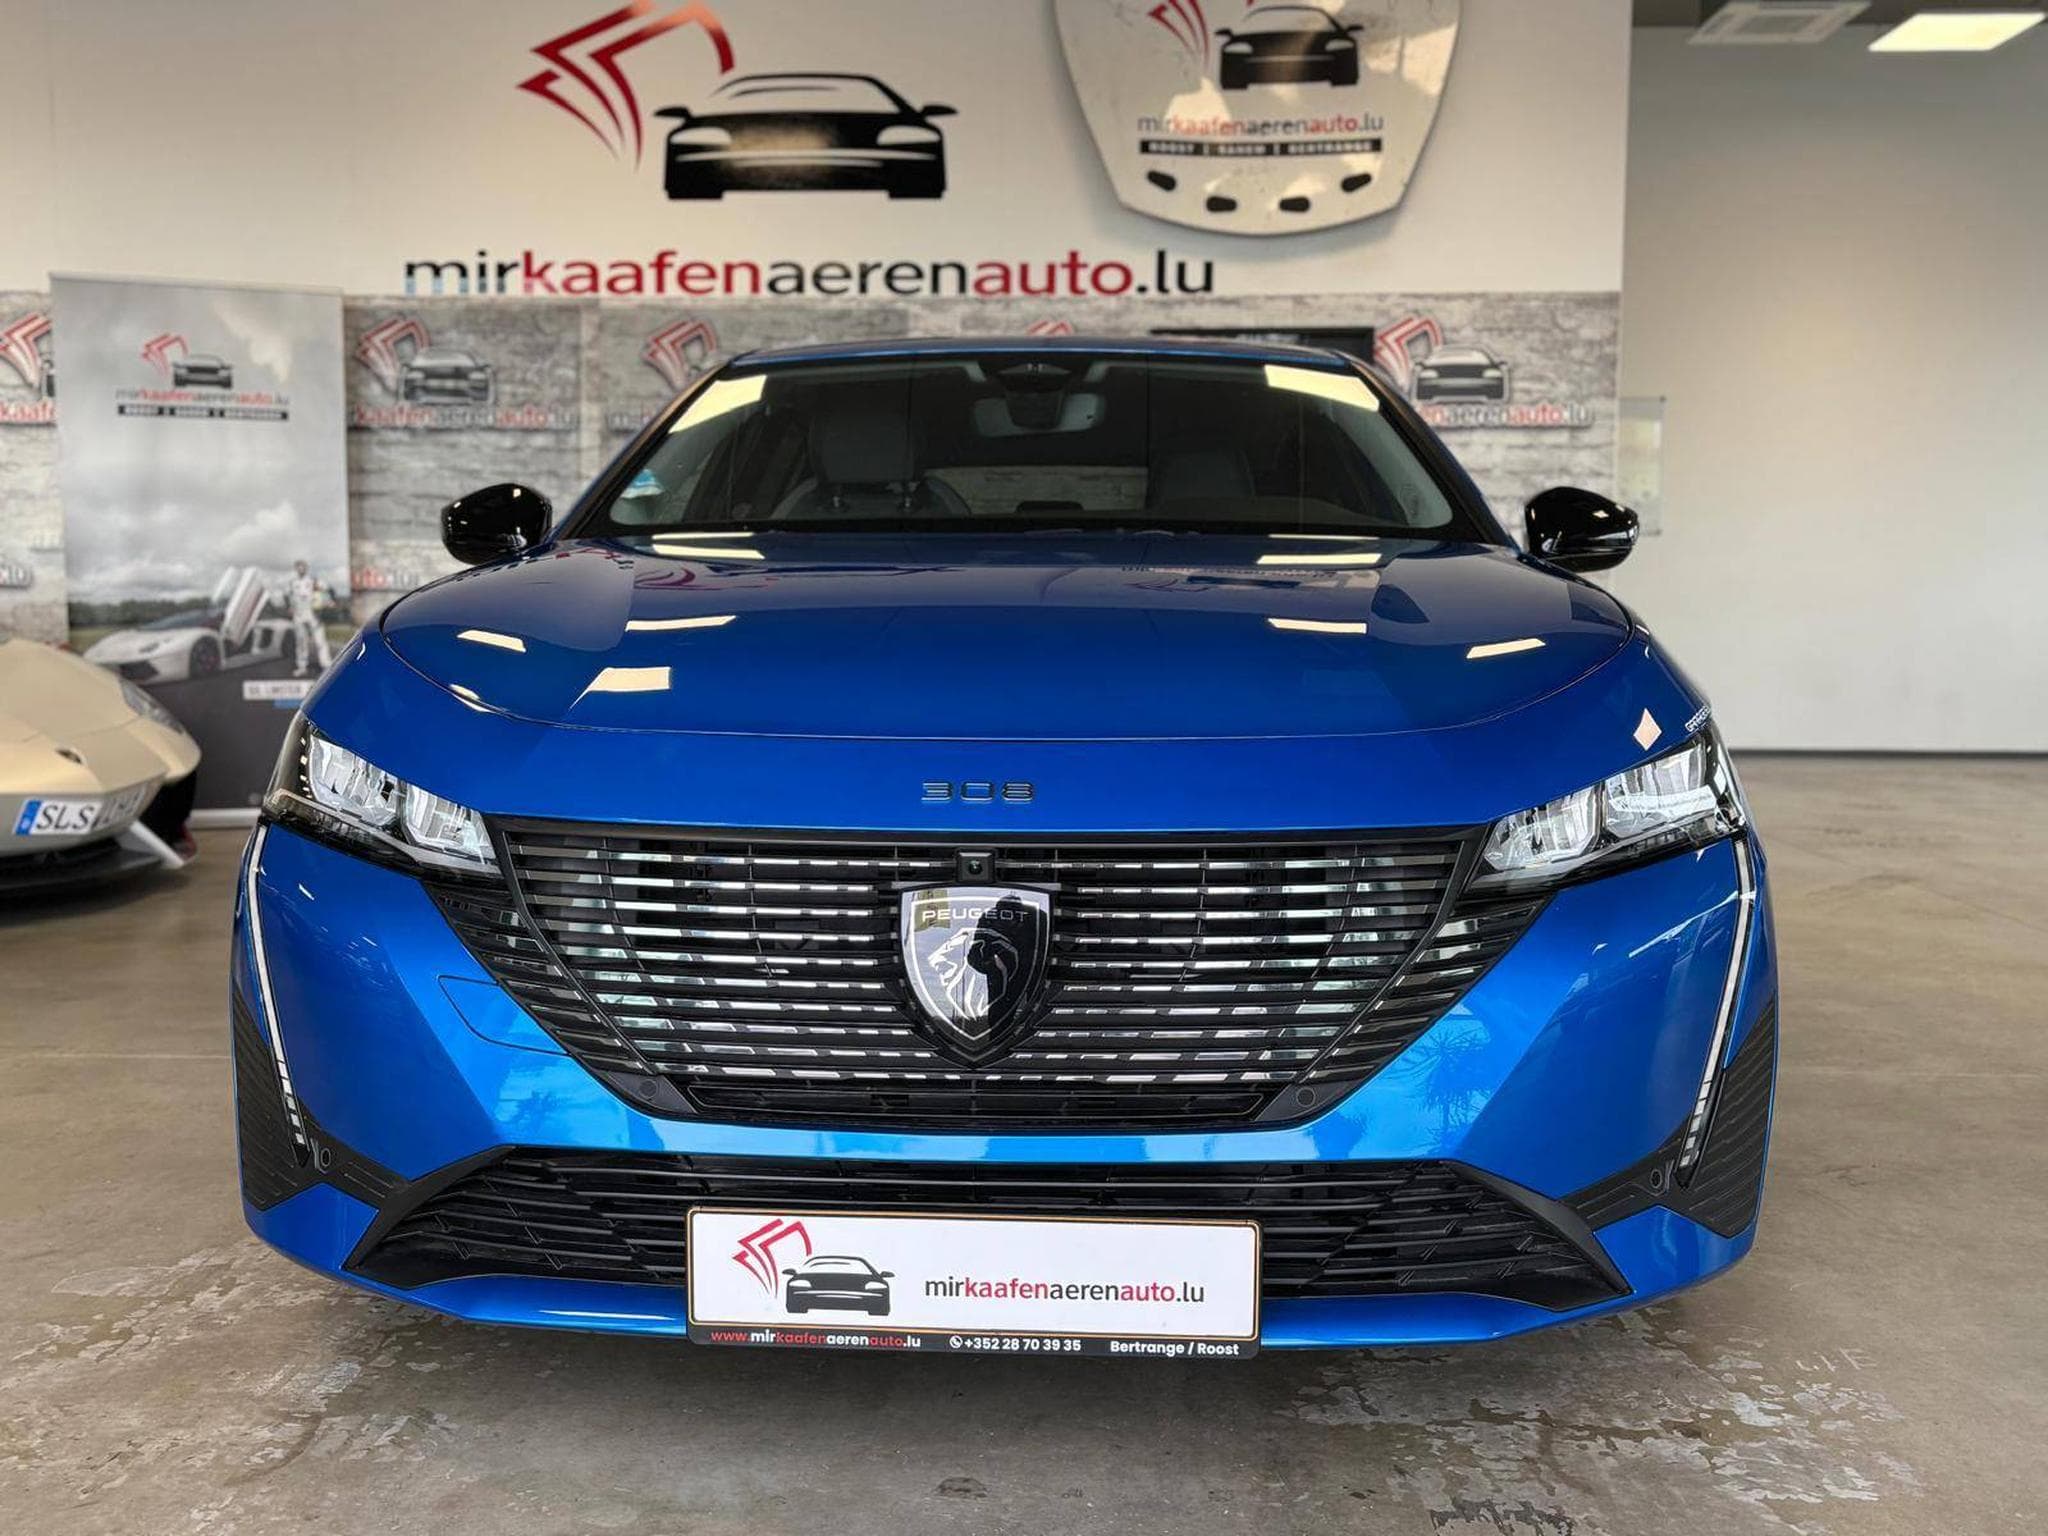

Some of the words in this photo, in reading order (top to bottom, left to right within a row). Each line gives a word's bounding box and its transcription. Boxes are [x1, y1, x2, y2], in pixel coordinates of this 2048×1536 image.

[1137, 112, 1384, 136] mirkaafenaerenauto.lu
[405, 250, 1214, 295] mirkaafenaerenauto.lu
[921, 781, 1034, 804] 308
[921, 907, 1026, 923] PEUGEOT
[925, 1275, 1205, 1303] mirkaafenaerenauto.lu
[711, 1328, 922, 1348] www.mirkaafenaerenauto.lu
[964, 1336, 1000, 1350] +352
[1002, 1338, 1020, 1350] 28
[1022, 1338, 1041, 1351] 70
[1043, 1339, 1061, 1351] 39
[1064, 1339, 1081, 1352] 35
[1110, 1340, 1185, 1357] Bertrange
[1197, 1342, 1239, 1356] Roost
